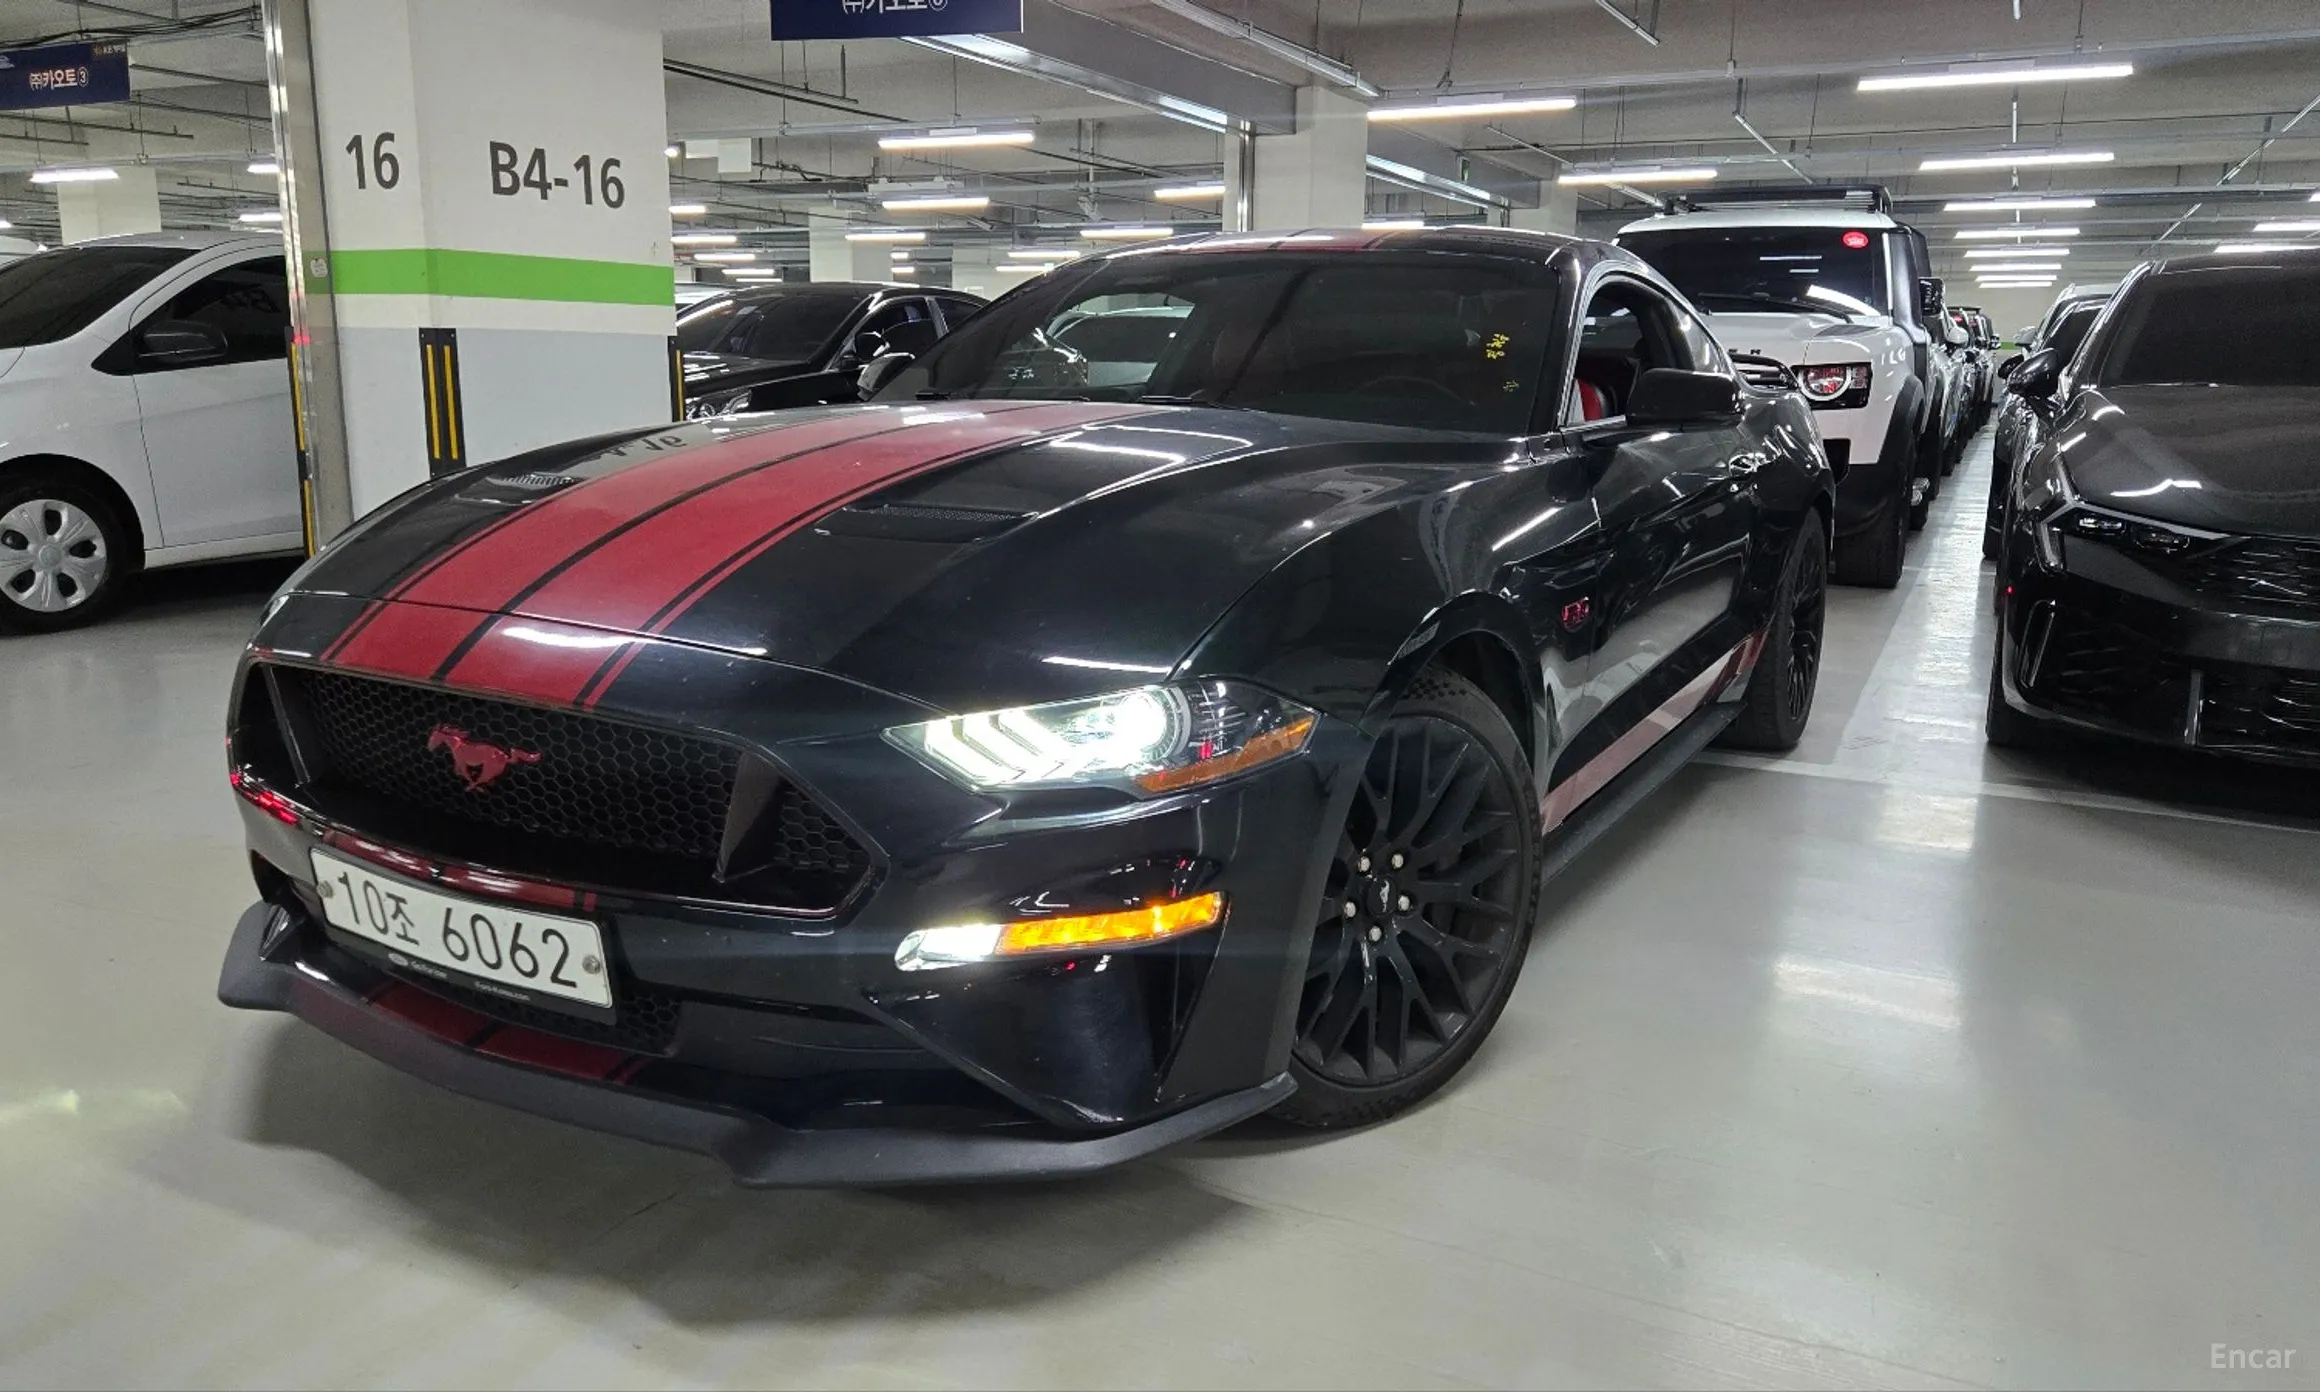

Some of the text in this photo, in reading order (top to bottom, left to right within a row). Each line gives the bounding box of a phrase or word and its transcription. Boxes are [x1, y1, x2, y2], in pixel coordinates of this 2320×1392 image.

[345, 131, 400, 190] 16
[489, 140, 625, 209] B4-16
[338, 871, 577, 988] 10조 6062
